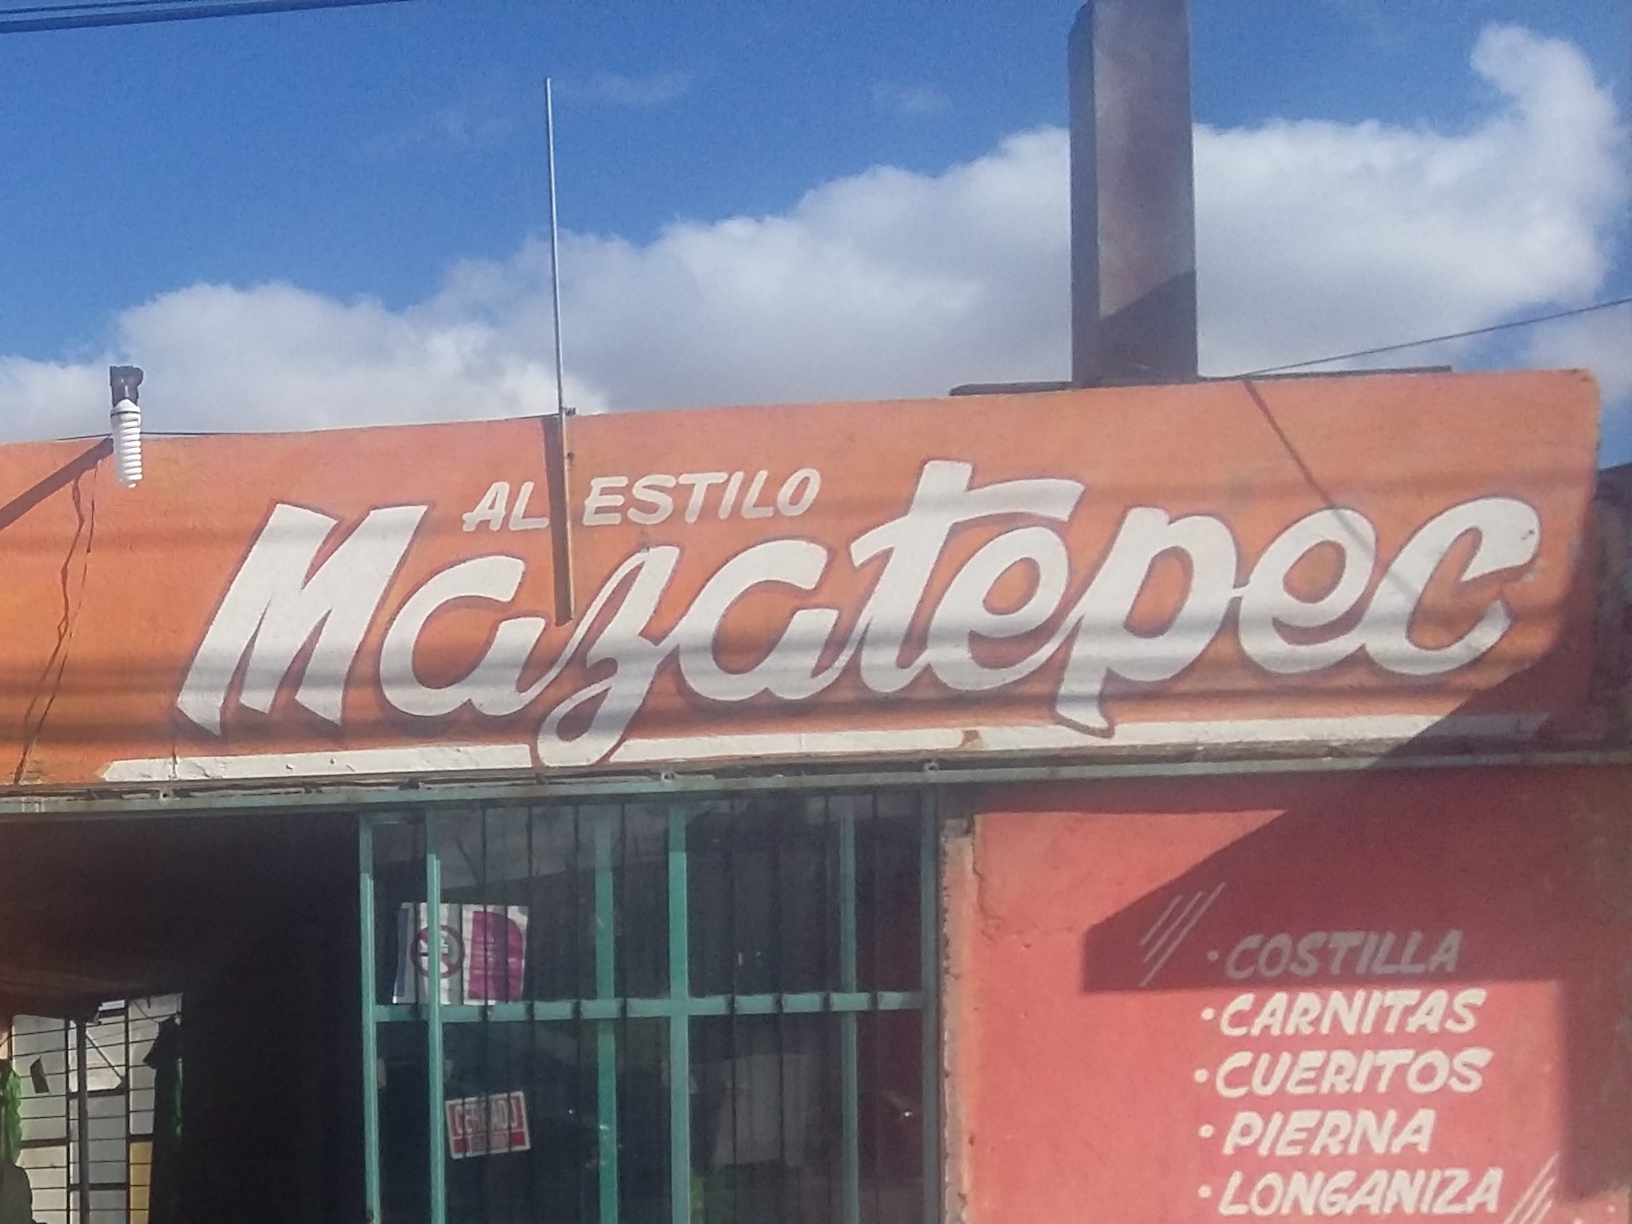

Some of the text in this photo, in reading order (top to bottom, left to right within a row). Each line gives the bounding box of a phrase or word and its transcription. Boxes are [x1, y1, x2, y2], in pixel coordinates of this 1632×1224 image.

[463, 467, 822, 532] AL ESTILO
[175, 460, 1541, 766] Mazatepec
[1225, 929, 1464, 980] COSTILLA
[1220, 988, 1487, 1037] CARNITAS
[1216, 1047, 1495, 1098] CUERITOS
[1223, 1109, 1436, 1157] PIERNA
[1218, 1166, 1505, 1217] LONGANIZA
